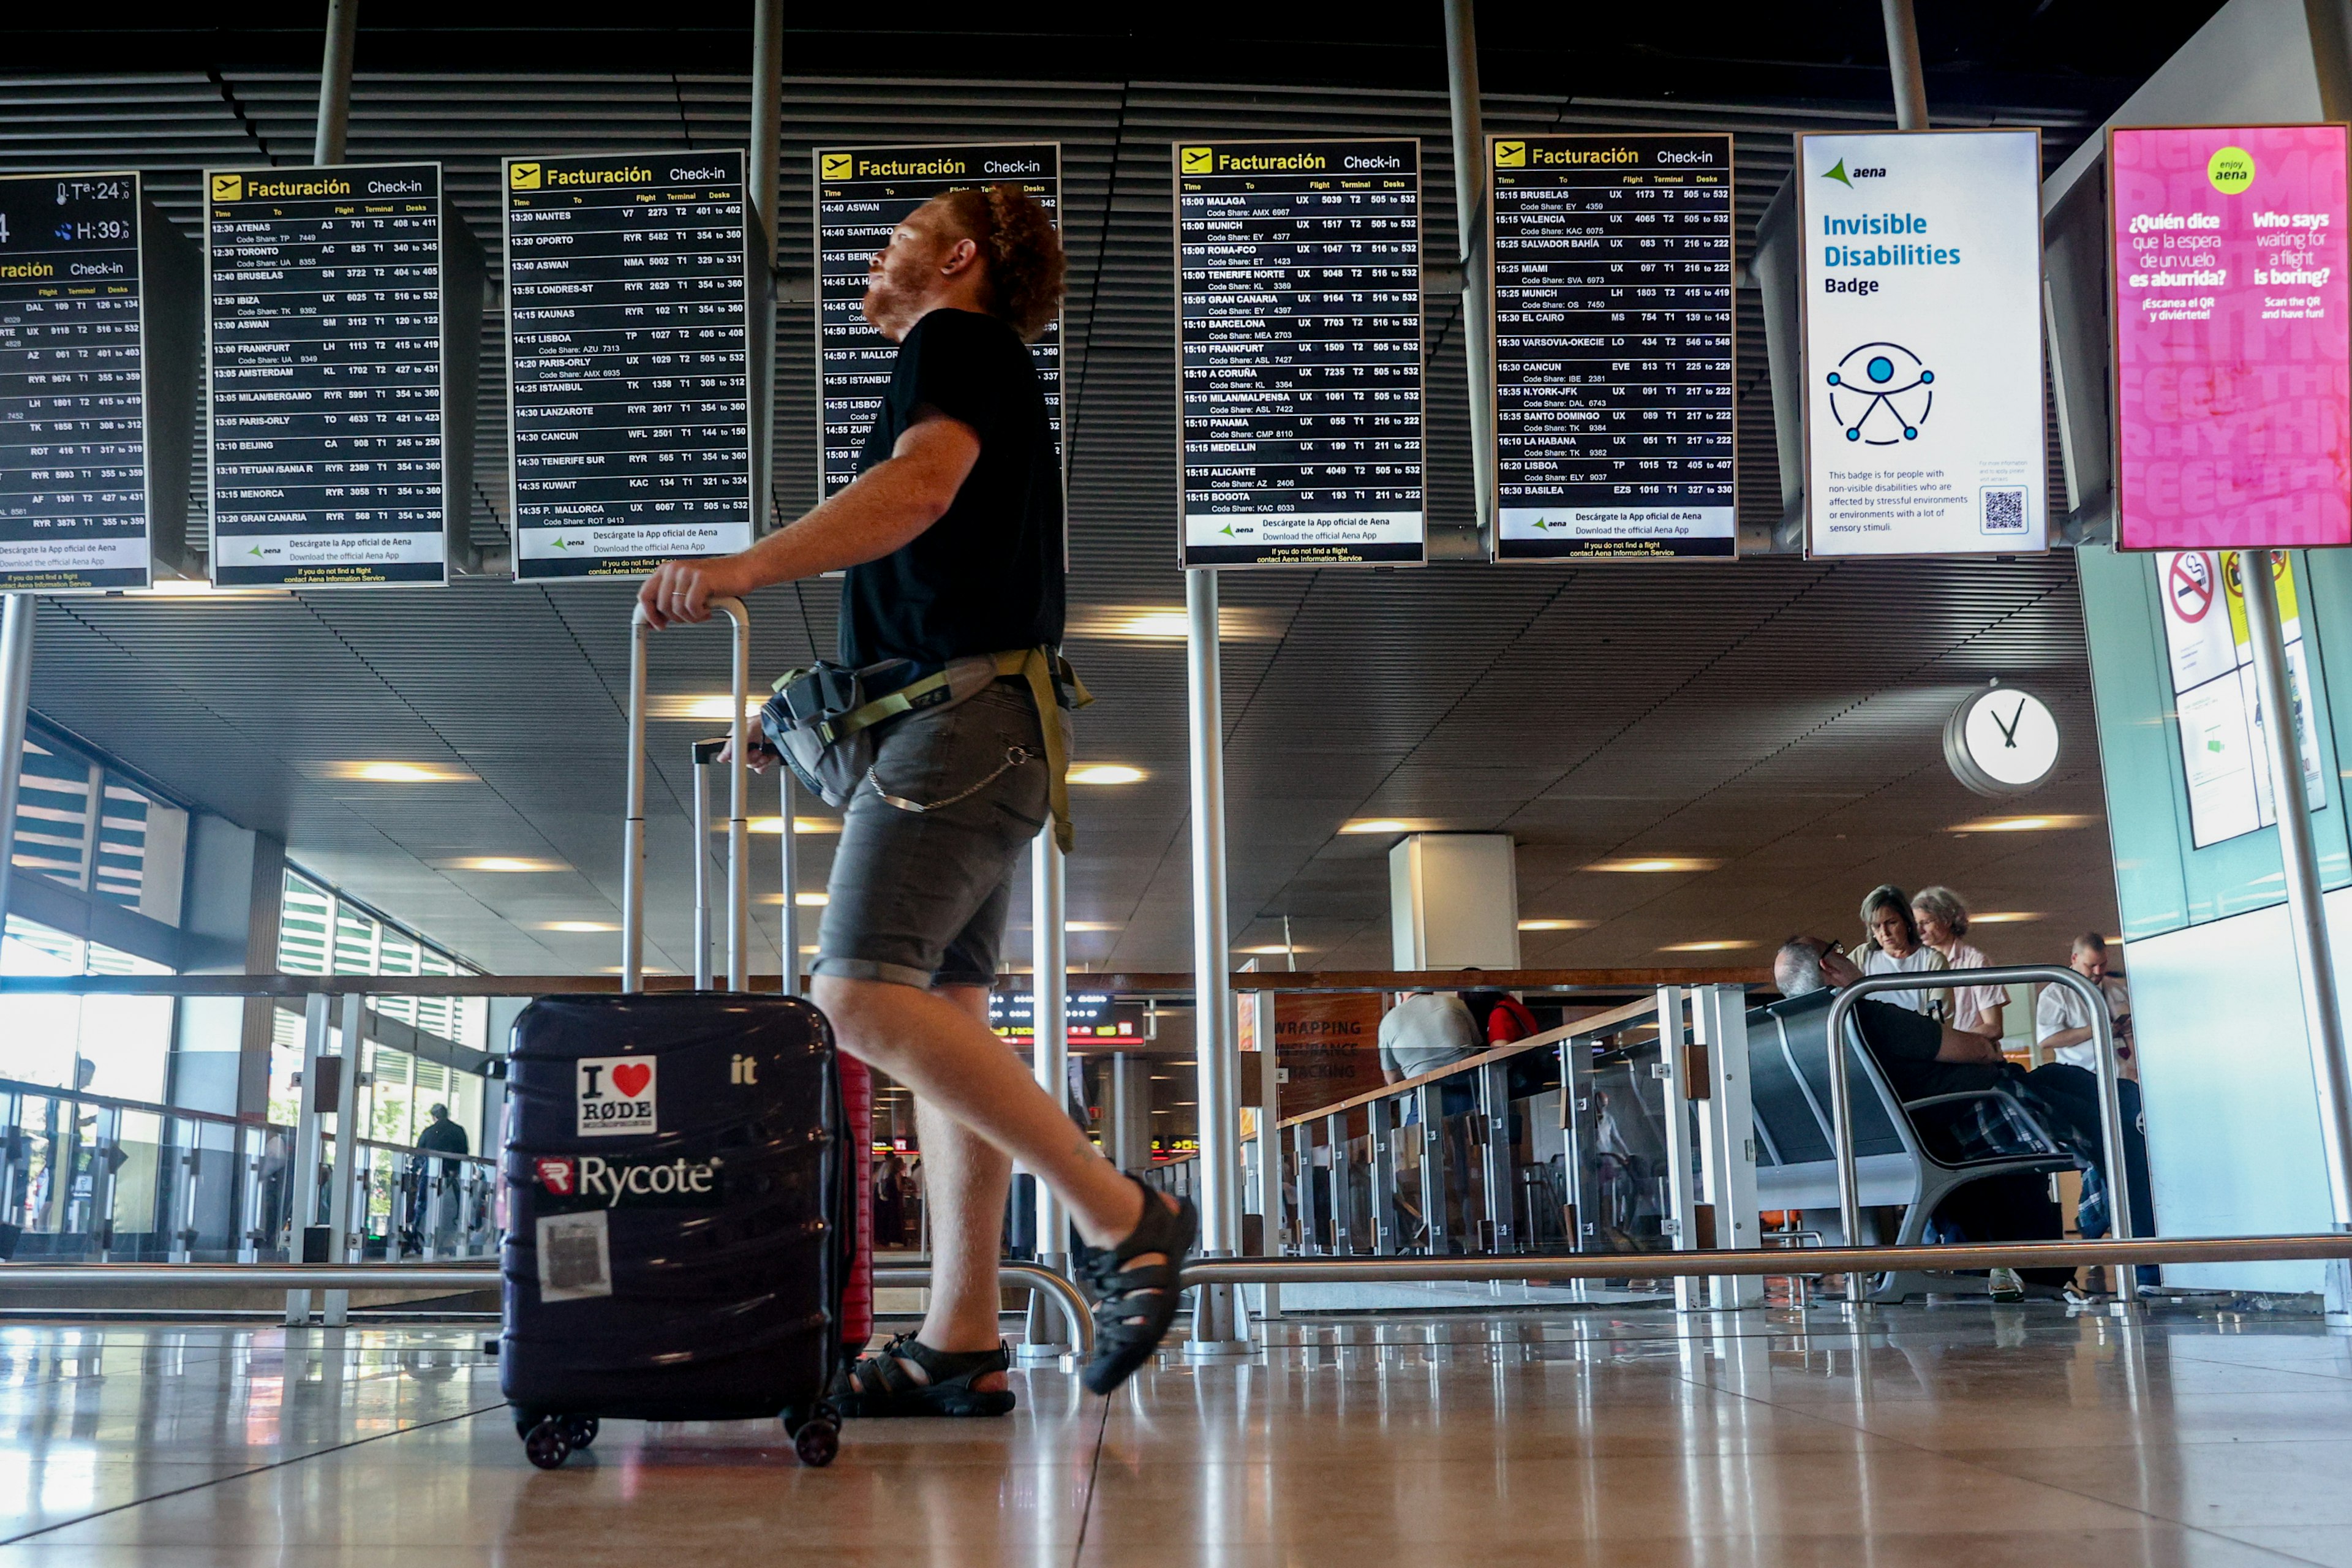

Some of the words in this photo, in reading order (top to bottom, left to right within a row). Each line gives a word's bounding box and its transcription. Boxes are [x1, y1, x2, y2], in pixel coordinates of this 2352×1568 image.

[1219, 153, 1325, 170] Facturación
[1344, 156, 1400, 168] Check-in
[1533, 148, 1638, 164] Facturación
[1657, 151, 1713, 163] Check-in
[859, 159, 965, 176] Facturación
[984, 160, 1039, 173] Check-in
[2220, 160, 2243, 170] enjoy
[548, 166, 651, 185] Facturación
[670, 167, 725, 180] Check-in
[1853, 168, 1886, 178] aena
[2215, 172, 2247, 180] aena
[249, 179, 350, 197] Facturación
[368, 180, 421, 193] Check-in
[821, 204, 844, 213] 14:40
[1182, 197, 1204, 206] 15:00
[1207, 197, 1246, 205] MALAGA
[1824, 213, 1927, 235] Invisible
[2128, 213, 2185, 233] ¿Quién
[2187, 213, 2220, 229] dice
[2253, 211, 2290, 228] Who
[2292, 213, 2329, 230] says
[213, 224, 234, 233] 12:30
[236, 223, 271, 232] ATENAS
[846, 227, 894, 236] SANTIAGO
[2133, 235, 2159, 252] que
[2163, 233, 2174, 248] la
[2177, 233, 2222, 251] espera
[2256, 231, 2305, 249] waiting
[2308, 230, 2326, 246] for
[1825, 244, 1960, 266] Disabilities
[2140, 253, 2158, 268] de
[2159, 254, 2177, 268] un
[2179, 252, 2215, 267] vuelo
[2269, 253, 2278, 266] a
[2281, 250, 2314, 269] flight
[70, 262, 123, 275] Check-in
[2129, 274, 2149, 287] es
[2151, 270, 2226, 286] aburrida?
[2254, 270, 2268, 285] is
[2270, 268, 2331, 287] boring?
[537, 284, 594, 294] LONDRES-ST
[625, 282, 643, 291] RYR
[1825, 277, 1879, 296] Badge
[2143, 298, 2186, 311] ¡Escanea
[2188, 297, 2198, 307] el
[2199, 297, 2215, 308] QR
[2264, 297, 2287, 306] Scan
[2289, 296, 2305, 306] the
[2306, 296, 2321, 307] QR
[2150, 311, 2157, 323] y
[2158, 309, 2211, 320] diviértete!
[2261, 309, 2280, 319] and
[2281, 309, 2304, 318] have
[2305, 308, 2324, 318] fun!
[214, 369, 236, 378] 13:05
[238, 368, 293, 377] AMSTERDAM
[540, 383, 583, 392] ISTANBUL
[1523, 387, 1577, 396] N.YORK-JFK
[540, 407, 594, 417] LANZAROTE
[1848, 471, 1872, 481] badge
[1897, 470, 1924, 480] people
[518, 482, 540, 491] 14:35
[543, 481, 577, 489] KUWAIT
[1829, 484, 1873, 492] non-visible
[240, 489, 284, 498] MENORCA
[1830, 497, 1863, 506] affected
[1864, 497, 1874, 507] by
[1877, 496, 1911, 505] stressful
[1263, 519, 1306, 528] Descárgate
[1317, 519, 1332, 527] App
[1863, 523, 1892, 532] stimuli.
[1275, 1021, 1361, 1035] WRAPPING
[731, 1054, 758, 1084] it
[582, 1065, 603, 1099] I
[582, 1101, 652, 1120] RØDE
[579, 1156, 714, 1207] Rycote
